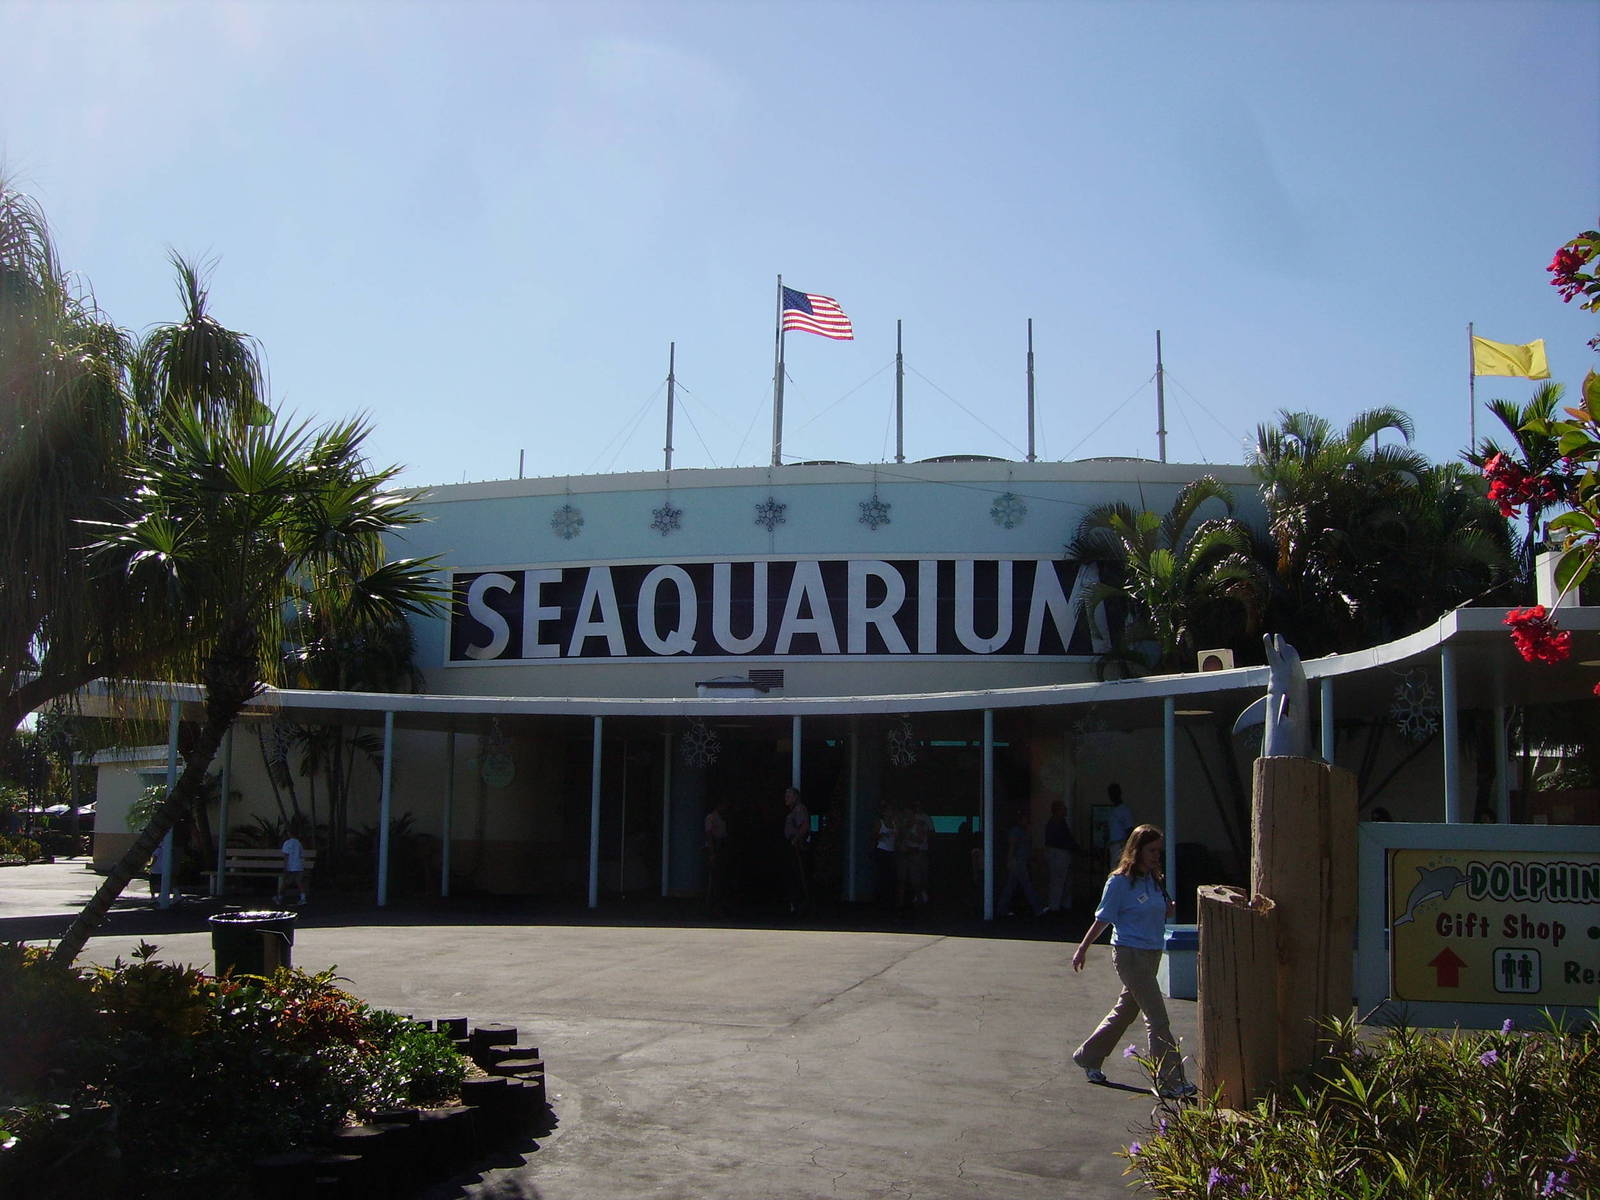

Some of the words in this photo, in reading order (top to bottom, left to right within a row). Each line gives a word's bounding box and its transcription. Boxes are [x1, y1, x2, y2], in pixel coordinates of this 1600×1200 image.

[464, 559, 1112, 660] SEAQUARIUM
[1469, 865, 1600, 899] DOLPHIN
[1436, 912, 1490, 938] Gift
[1502, 913, 1566, 947] Shop
[1564, 960, 1600, 985] Re
